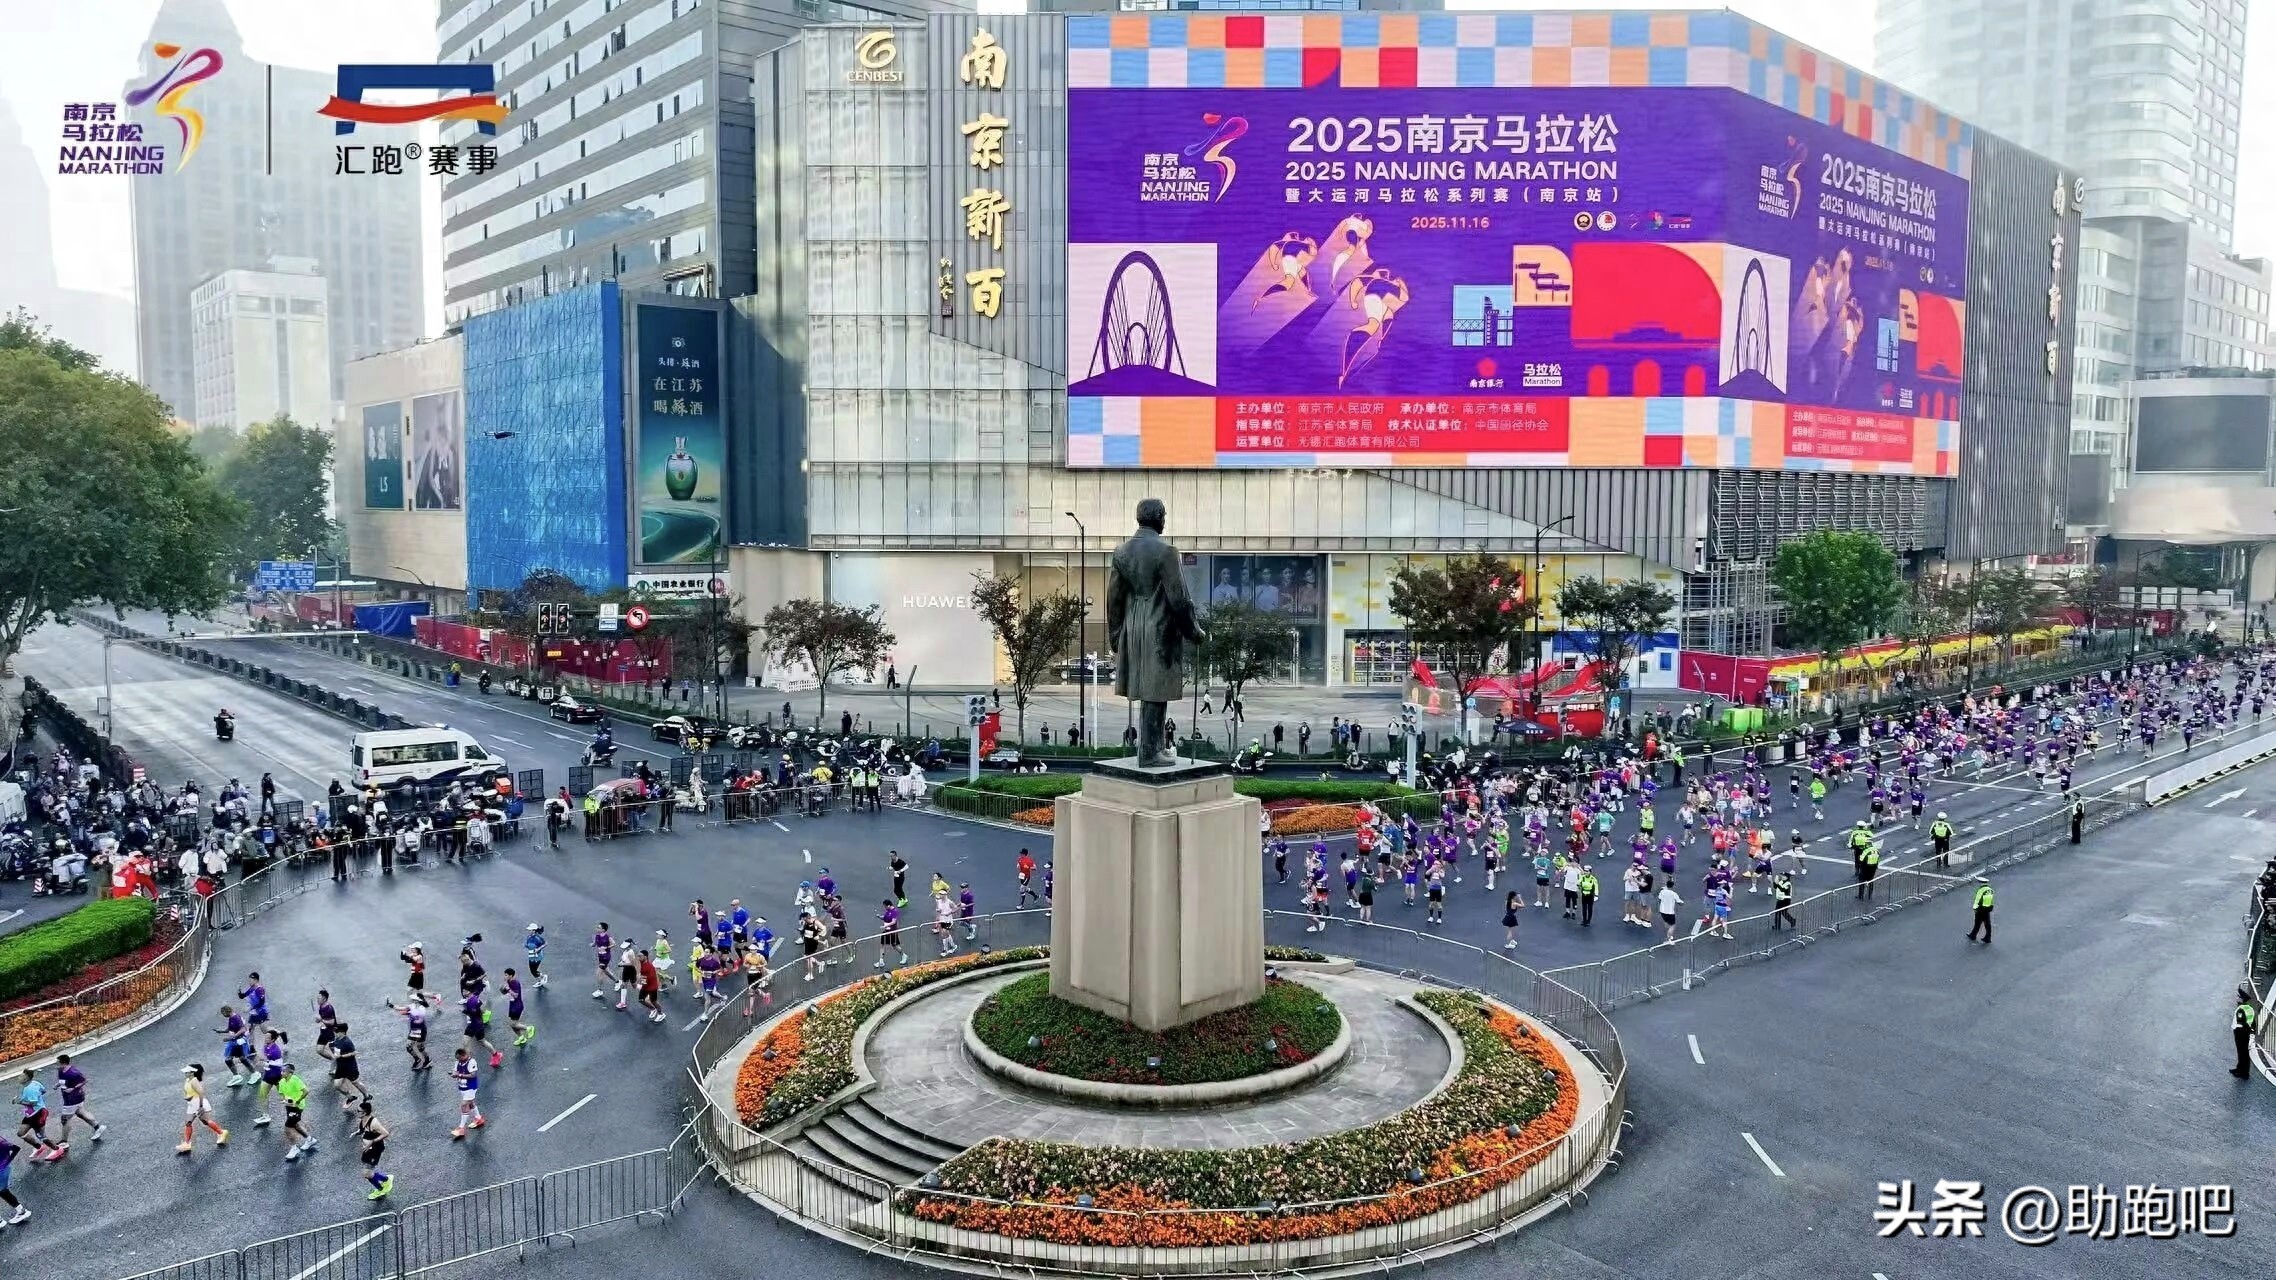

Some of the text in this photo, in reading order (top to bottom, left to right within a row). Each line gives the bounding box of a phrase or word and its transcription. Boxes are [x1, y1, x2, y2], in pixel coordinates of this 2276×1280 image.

[847, 71, 904, 82] CENBEST
[1287, 113, 1619, 154] 2025南京马拉松
[1144, 153, 1179, 166] 南京
[961, 28, 1010, 318] 南京新百
[1143, 166, 1196, 180] 马拉松
[1285, 161, 1617, 181] 2025 NANJING MARATHON
[1141, 182, 1210, 192] NANJING
[1821, 152, 1937, 221] 2025南京马拉松
[1140, 193, 1209, 201] MARATHON
[1411, 216, 1490, 229] 2025.11.16
[1819, 192, 1936, 243] 2025 NANJING MARATHON
[1523, 363, 1562, 376] 马拉松
[653, 376, 703, 392] 在江苏
[652, 579, 705, 589] 中国农业银行
